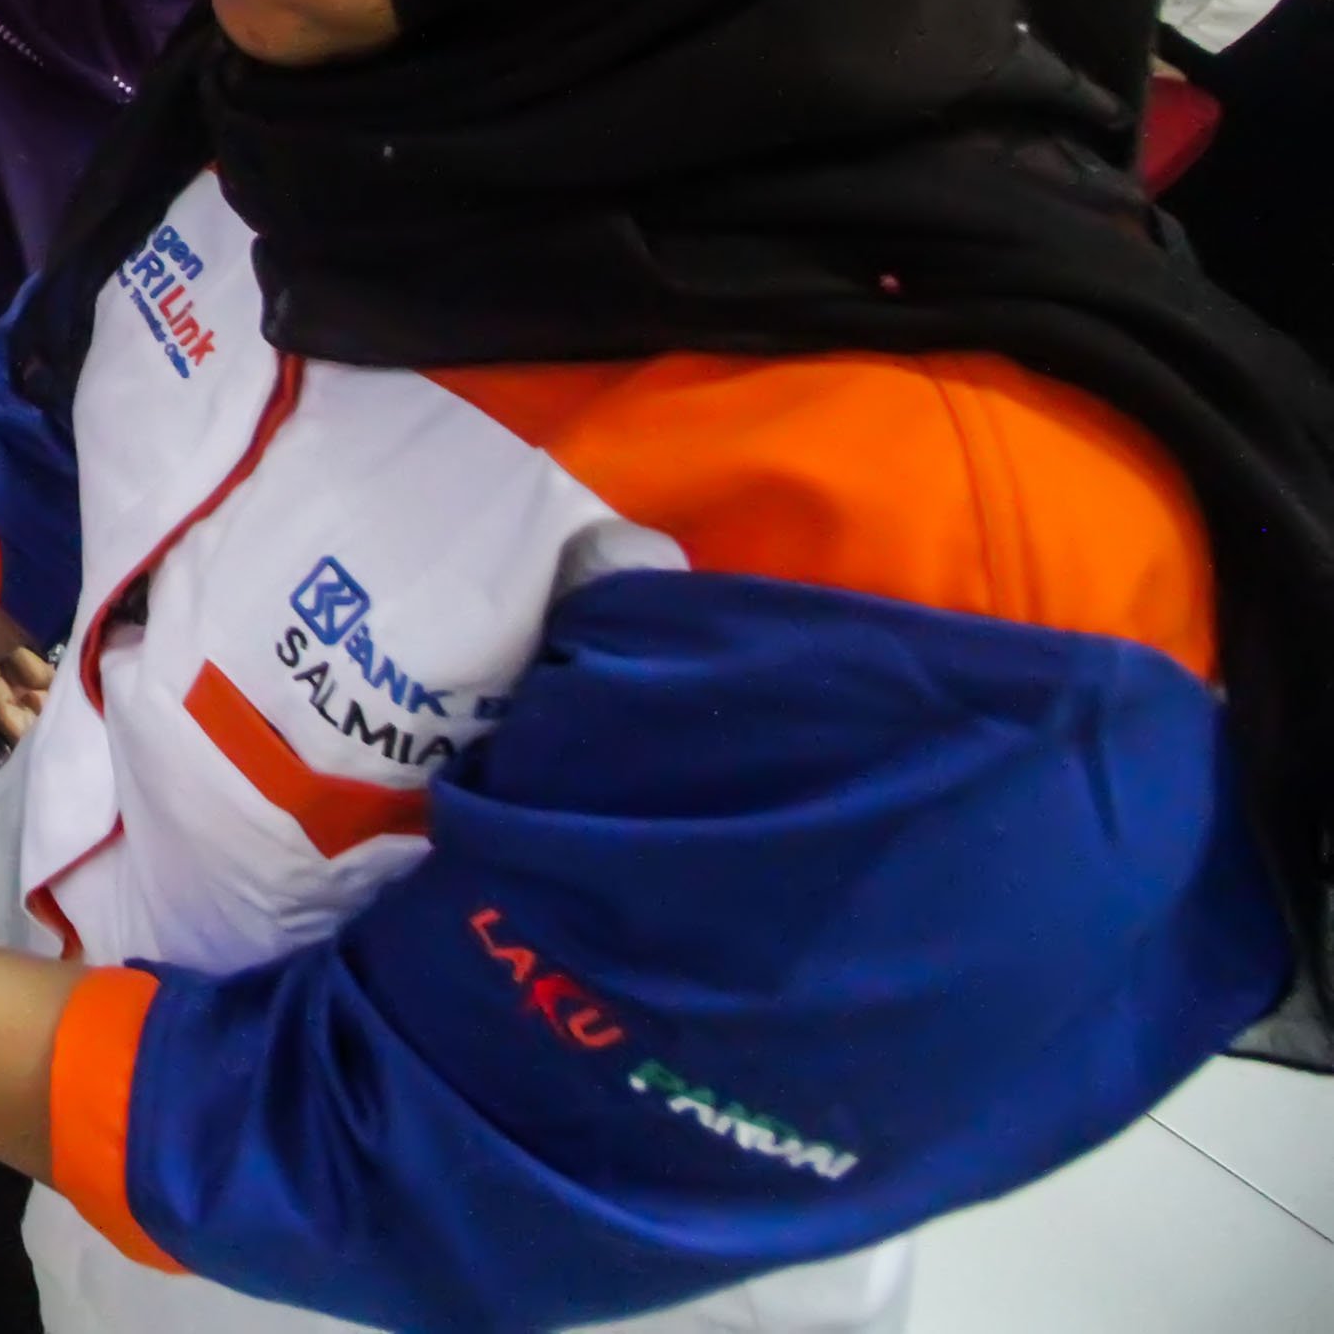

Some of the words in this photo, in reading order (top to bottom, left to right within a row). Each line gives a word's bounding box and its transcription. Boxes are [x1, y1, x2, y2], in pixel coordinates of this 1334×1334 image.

[128, 249, 216, 367] RILink
[151, 224, 204, 281] gen
[469, 908, 625, 1049] LAKU
